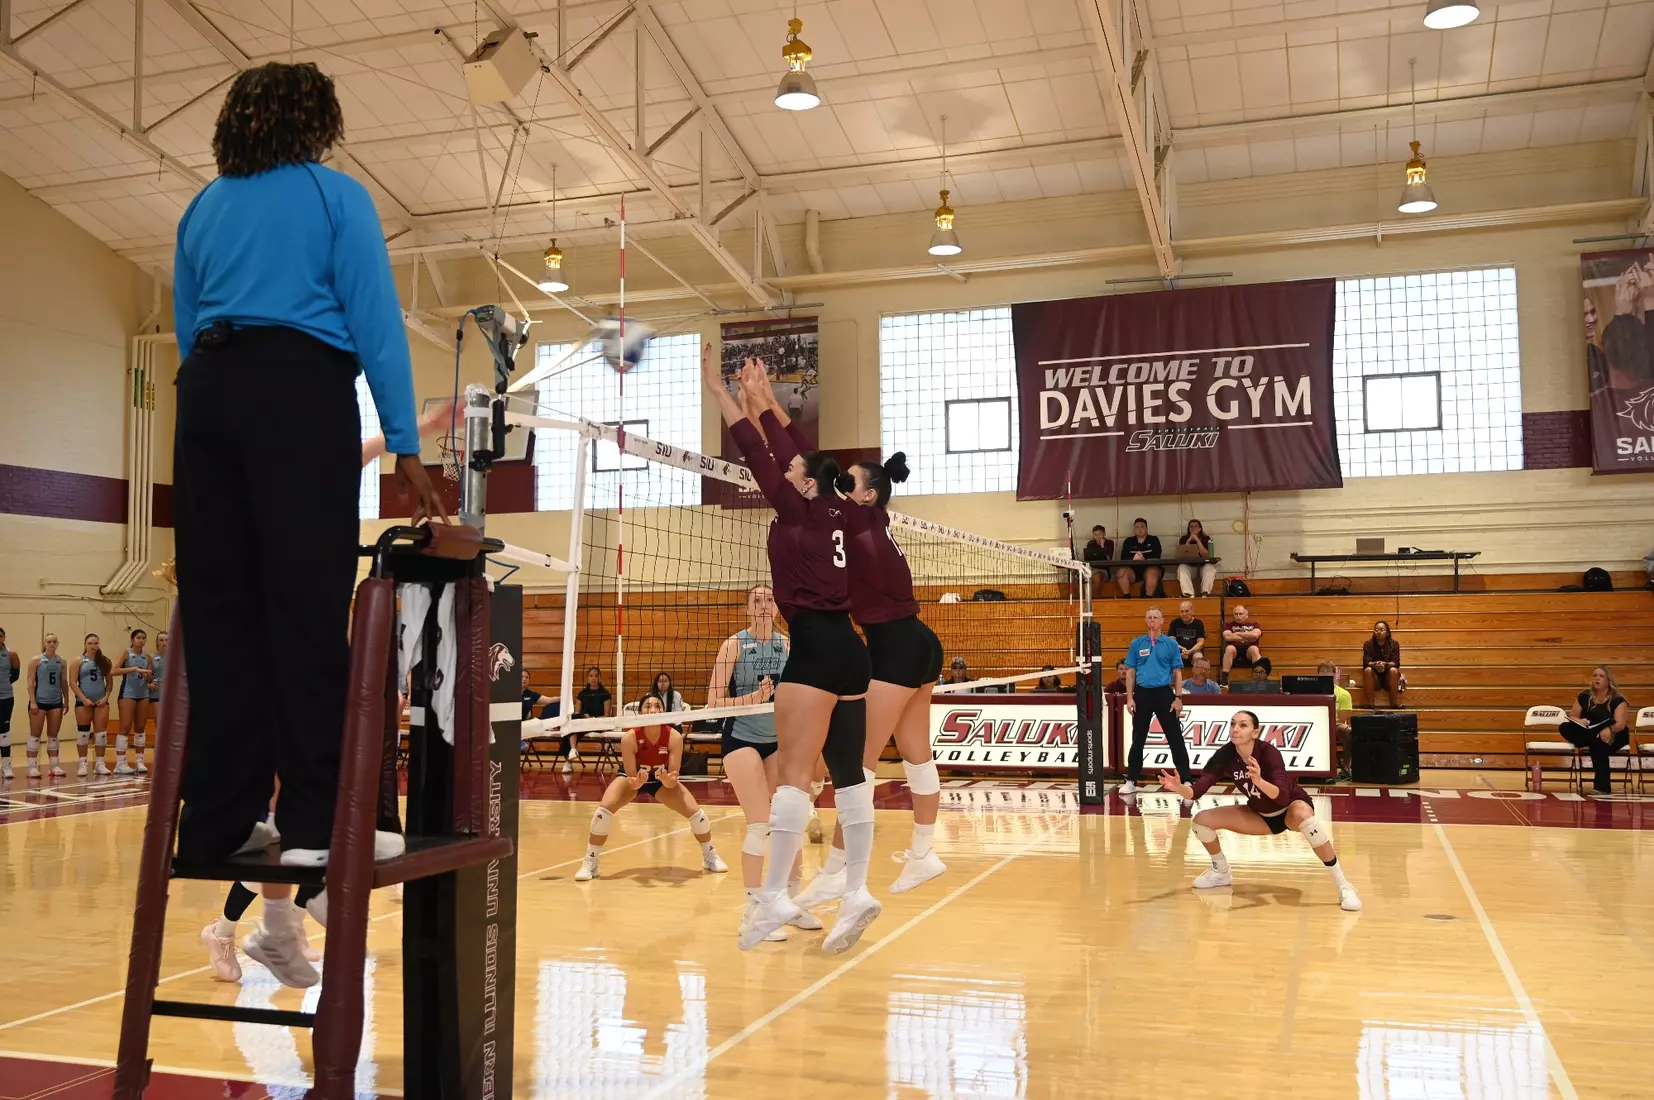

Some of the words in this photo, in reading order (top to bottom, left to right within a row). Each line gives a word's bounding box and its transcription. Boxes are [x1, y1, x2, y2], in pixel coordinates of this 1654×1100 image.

[1045, 359, 1199, 389] WELCOME
[1211, 355, 1254, 378] TO
[1039, 381, 1193, 430] DAVIES
[1206, 374, 1312, 421] GYM
[655, 442, 672, 458] SIU
[700, 456, 715, 471] SIU
[1125, 430, 1220, 452] SALUKI
[1616, 436, 1654, 454] SA
[832, 530, 847, 568] 3
[89, 668, 98, 682] 5
[933, 709, 1079, 748] SALUK
[1086, 729, 1094, 749] sports
[1243, 781, 1261, 799] 14
[486, 760, 502, 918] UNIVRSITY
[484, 923, 499, 1036] ILLINOIS
